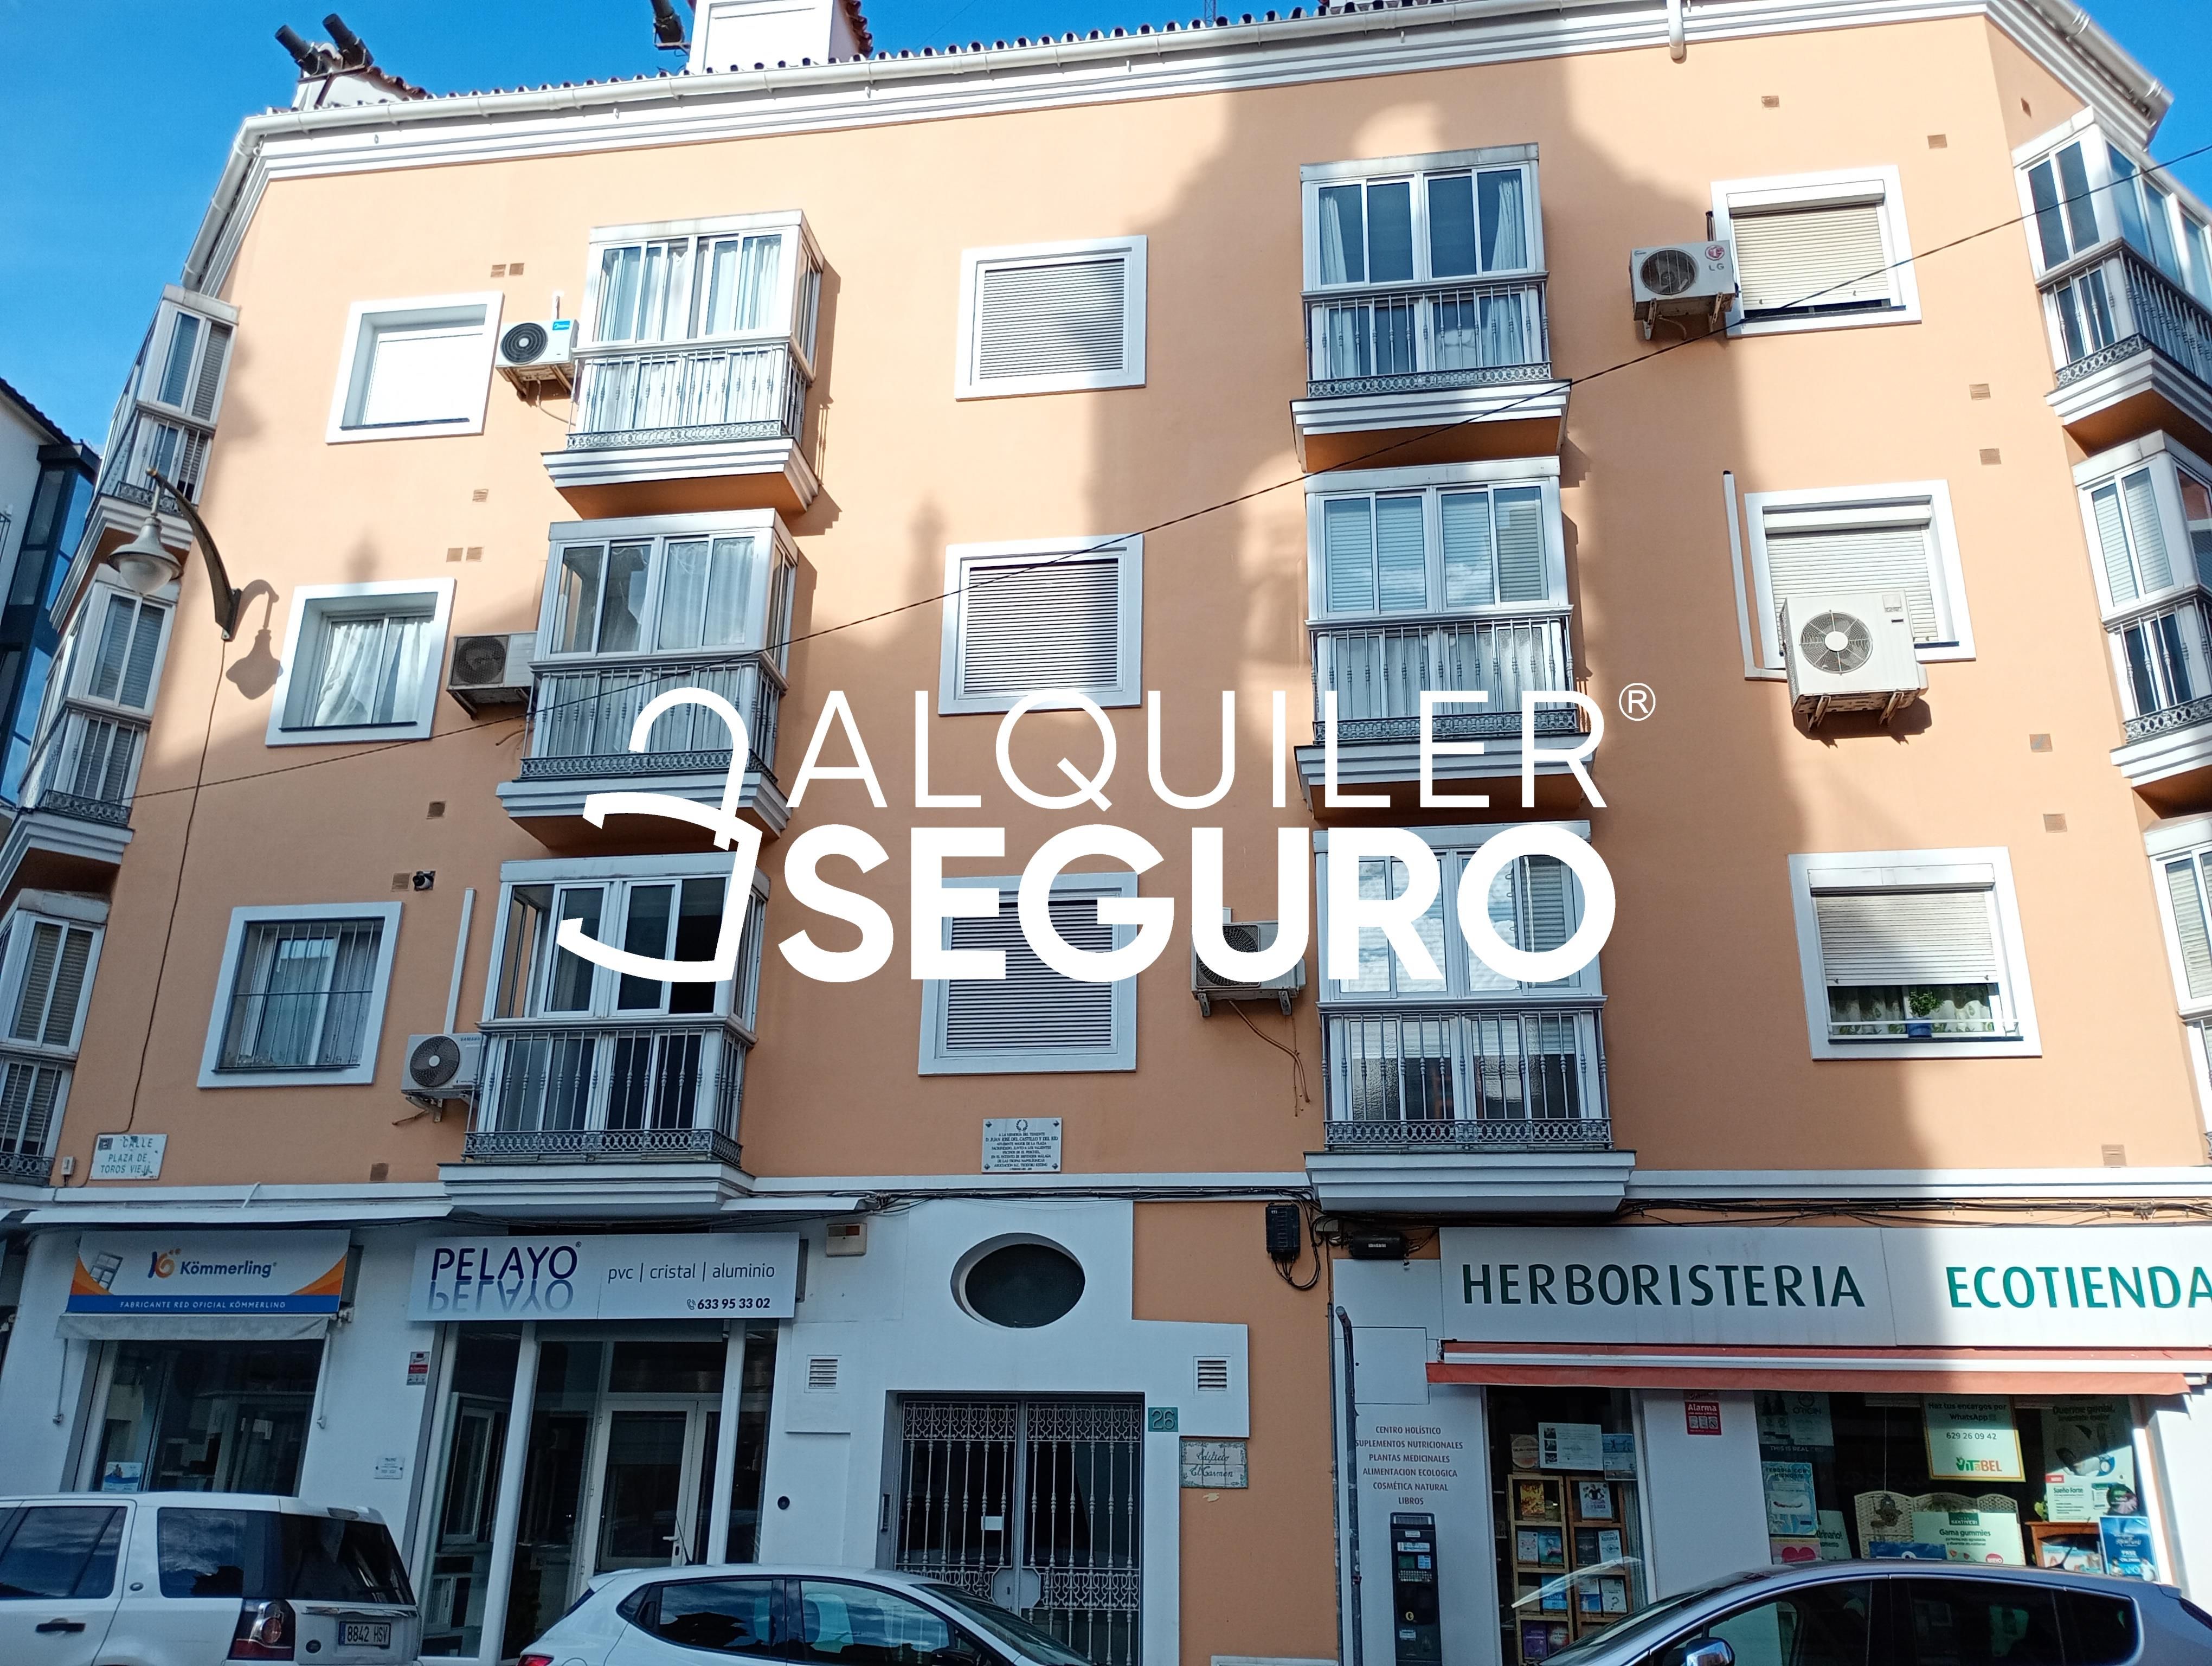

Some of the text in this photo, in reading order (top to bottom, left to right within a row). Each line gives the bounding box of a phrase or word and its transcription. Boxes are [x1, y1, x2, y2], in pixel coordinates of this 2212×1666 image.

[1709, 262, 1725, 271] LG
[123, 1137, 153, 1148] CALLE
[108, 1154, 147, 1162] PLAZA DE
[100, 1165, 152, 1175] TOROS VIEJA
[431, 1245, 578, 1280] PELAYO
[180, 1260, 272, 1278] Kömmerling
[607, 1261, 775, 1284] pvc cristal aluminio
[1462, 1264, 2212, 1309] HERBORISTERIA ECOTIENDA
[229, 1300, 286, 1308] KÖMMERLING
[697, 1298, 770, 1310] 633 95 33 02
[1688, 1403, 1718, 1412] Alarma
[1152, 1409, 1175, 1430] 26
[1405, 1425, 1441, 1434] HOLÍSTICO
[1355, 1440, 1463, 1449] SUPLEMENTOS NUTRICIONALES
[1196, 1451, 1230, 1463] Edificio
[1189, 1464, 1234, 1478] El Carmen
[1362, 1468, 1457, 1477] ALIMENTACION ECOLOGICA
[1373, 1481, 1449, 1491] COSMÉTICA NATURAL
[1398, 1497, 1424, 1505] LIBROS
[348, 1626, 370, 1642] 8842
